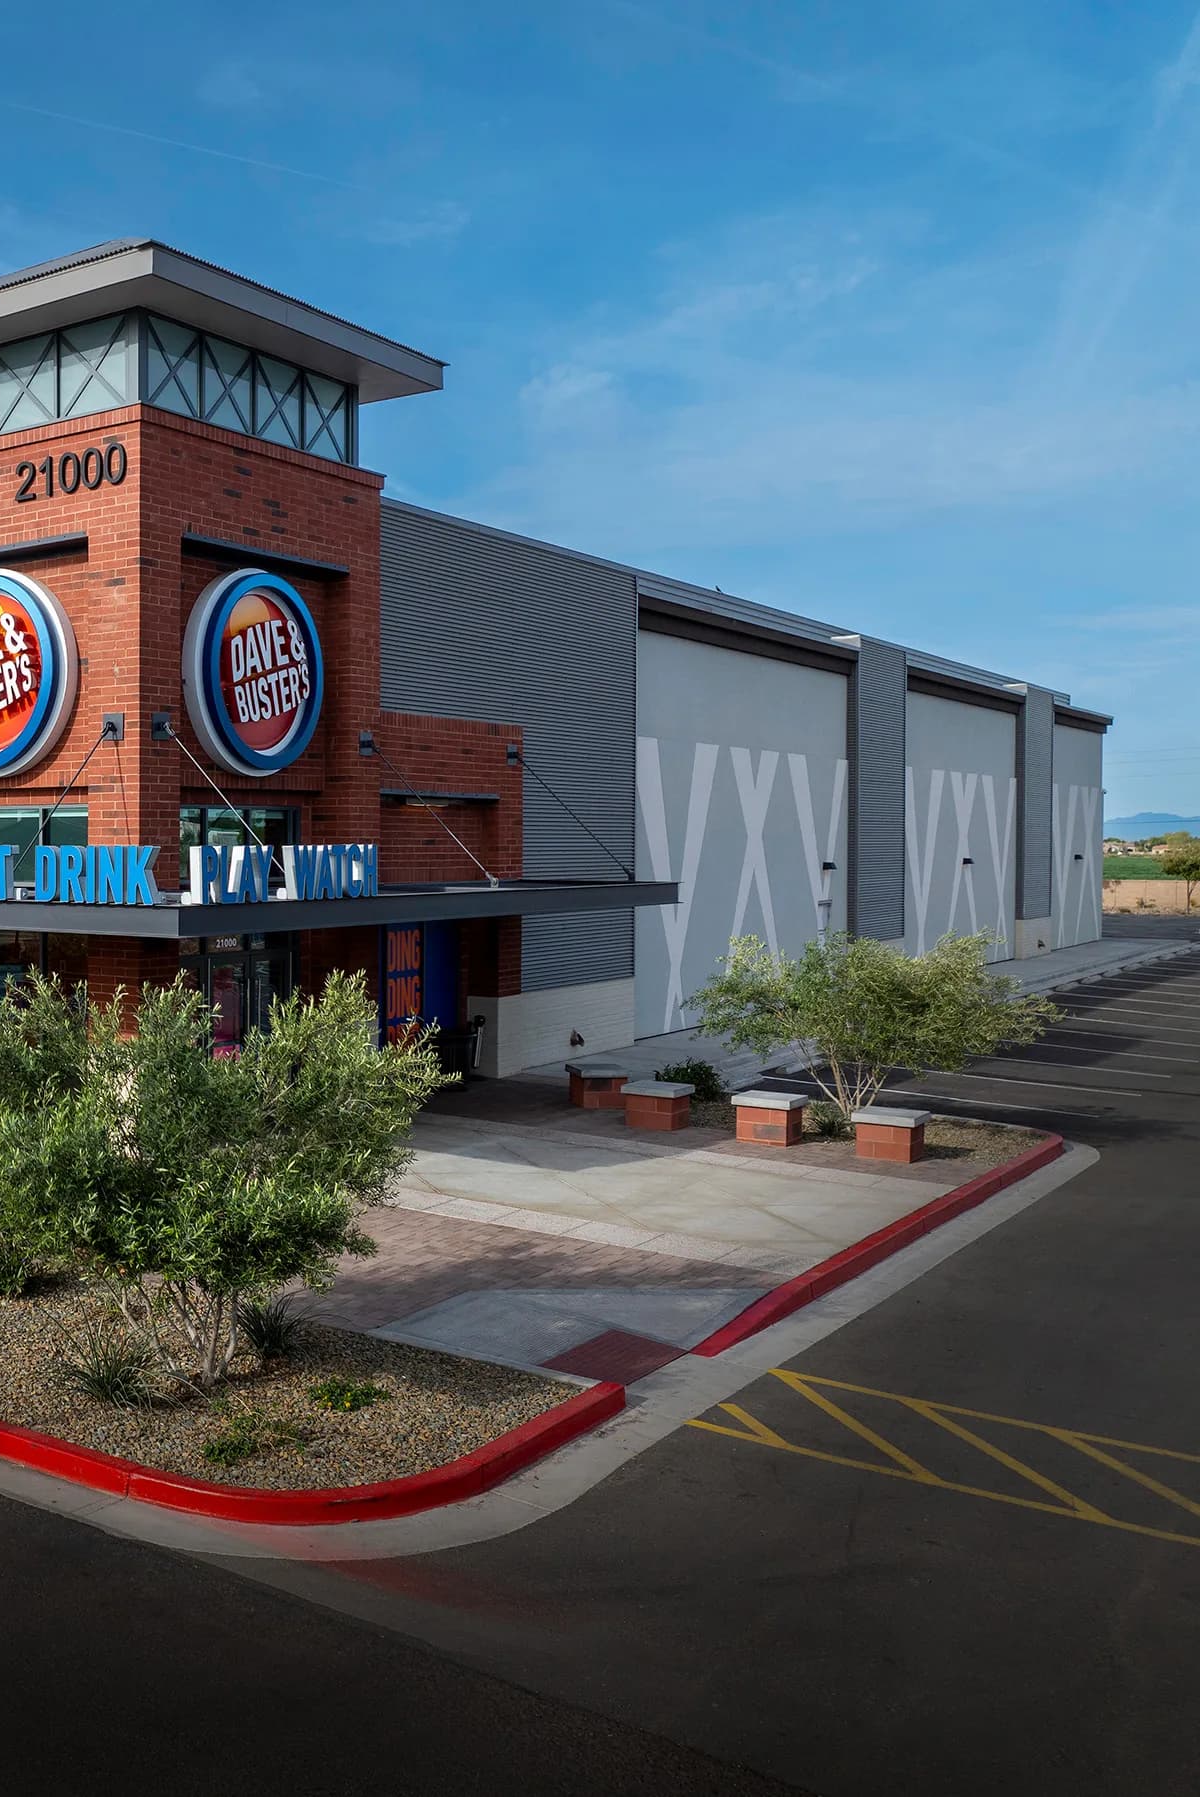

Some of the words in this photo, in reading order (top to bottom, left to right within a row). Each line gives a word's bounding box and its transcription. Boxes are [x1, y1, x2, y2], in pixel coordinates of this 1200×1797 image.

[15, 442, 127, 503] 21000
[0, 612, 28, 654] &
[231, 619, 289, 683] DAVE
[287, 620, 307, 661] &
[234, 663, 310, 723] BUSTER'S
[35, 845, 154, 905] DRINK
[200, 845, 274, 905] PLAY
[293, 843, 379, 900] WATCH
[216, 938, 237, 948] 21000
[387, 929, 420, 973] DING
[387, 975, 420, 1019] DING
